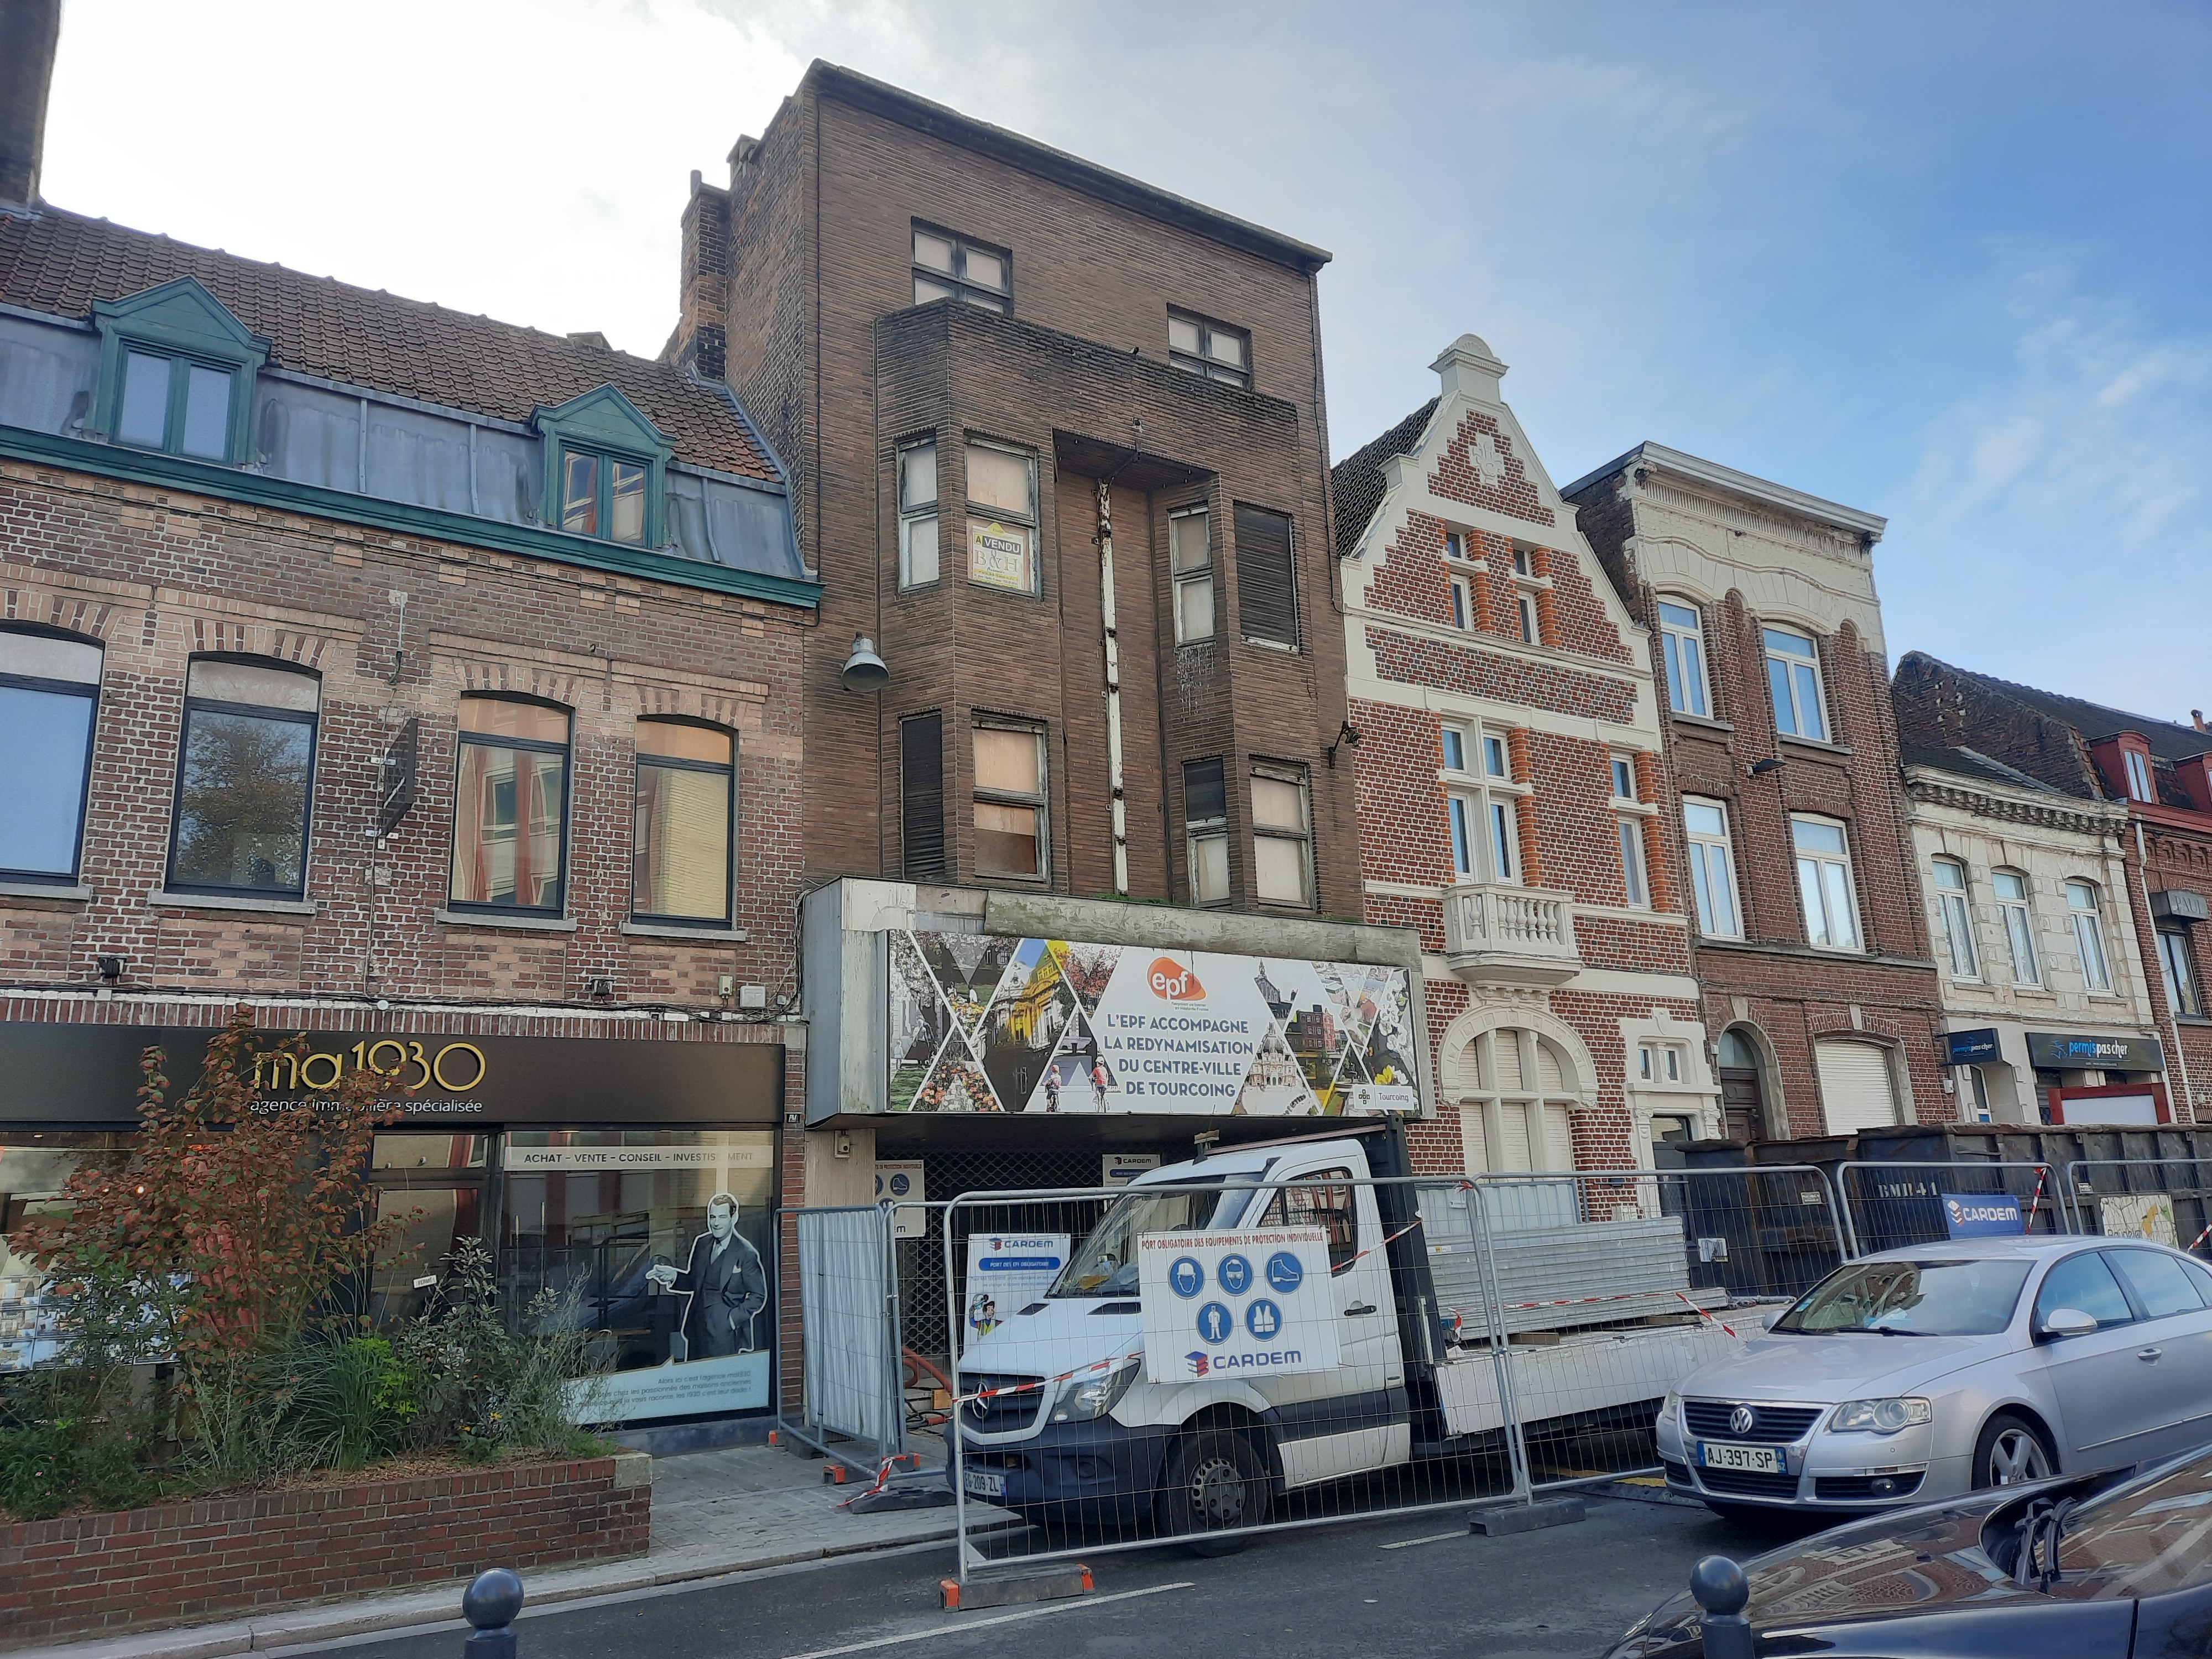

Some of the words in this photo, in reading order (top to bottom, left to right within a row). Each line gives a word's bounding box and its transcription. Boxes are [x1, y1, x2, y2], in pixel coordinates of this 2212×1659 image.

[984, 538, 1020, 554] VENDU
[2174, 895, 2203, 914] PAUL
[1152, 971, 1189, 1000] epf
[1107, 1014, 1146, 1029] L'EPF
[1150, 1016, 1249, 1034] ACCOMPAGNE
[1104, 1036, 1123, 1050] LA
[1127, 1037, 1254, 1055] REDYNAMISATION
[1119, 1058, 1139, 1073] DU
[1143, 1060, 1241, 1076] CENTRE-VILLE
[1126, 1081, 1145, 1095] DE
[1149, 1082, 1236, 1097] TOURCOING
[1378, 1093, 1409, 1103] Tourcoing
[405, 1099, 483, 1115] spécialisée
[524, 1154, 562, 1163] ACHAT
[575, 1154, 607, 1162] VENTE
[619, 1153, 662, 1162] CONSEIL
[673, 1152, 753, 1161] INVESTISMENT
[1963, 1207, 2018, 1222] CARDEM
[1141, 1240, 1155, 1250] PORT
[1157, 1238, 1193, 1249] OBLIGATOIRE
[1194, 1238, 1204, 1248] DES
[1206, 1235, 1243, 1247] EQUIPEMENTS
[1244, 1235, 1251, 1245] DE
[1252, 1233, 1285, 1244] PROTECTION
[1287, 1232, 1323, 1243] INDIVIDUELLE
[1213, 1350, 1302, 1370] CARDEM
[641, 1385, 678, 1395] passionnés
[1777, 1462, 1786, 1471] 62
